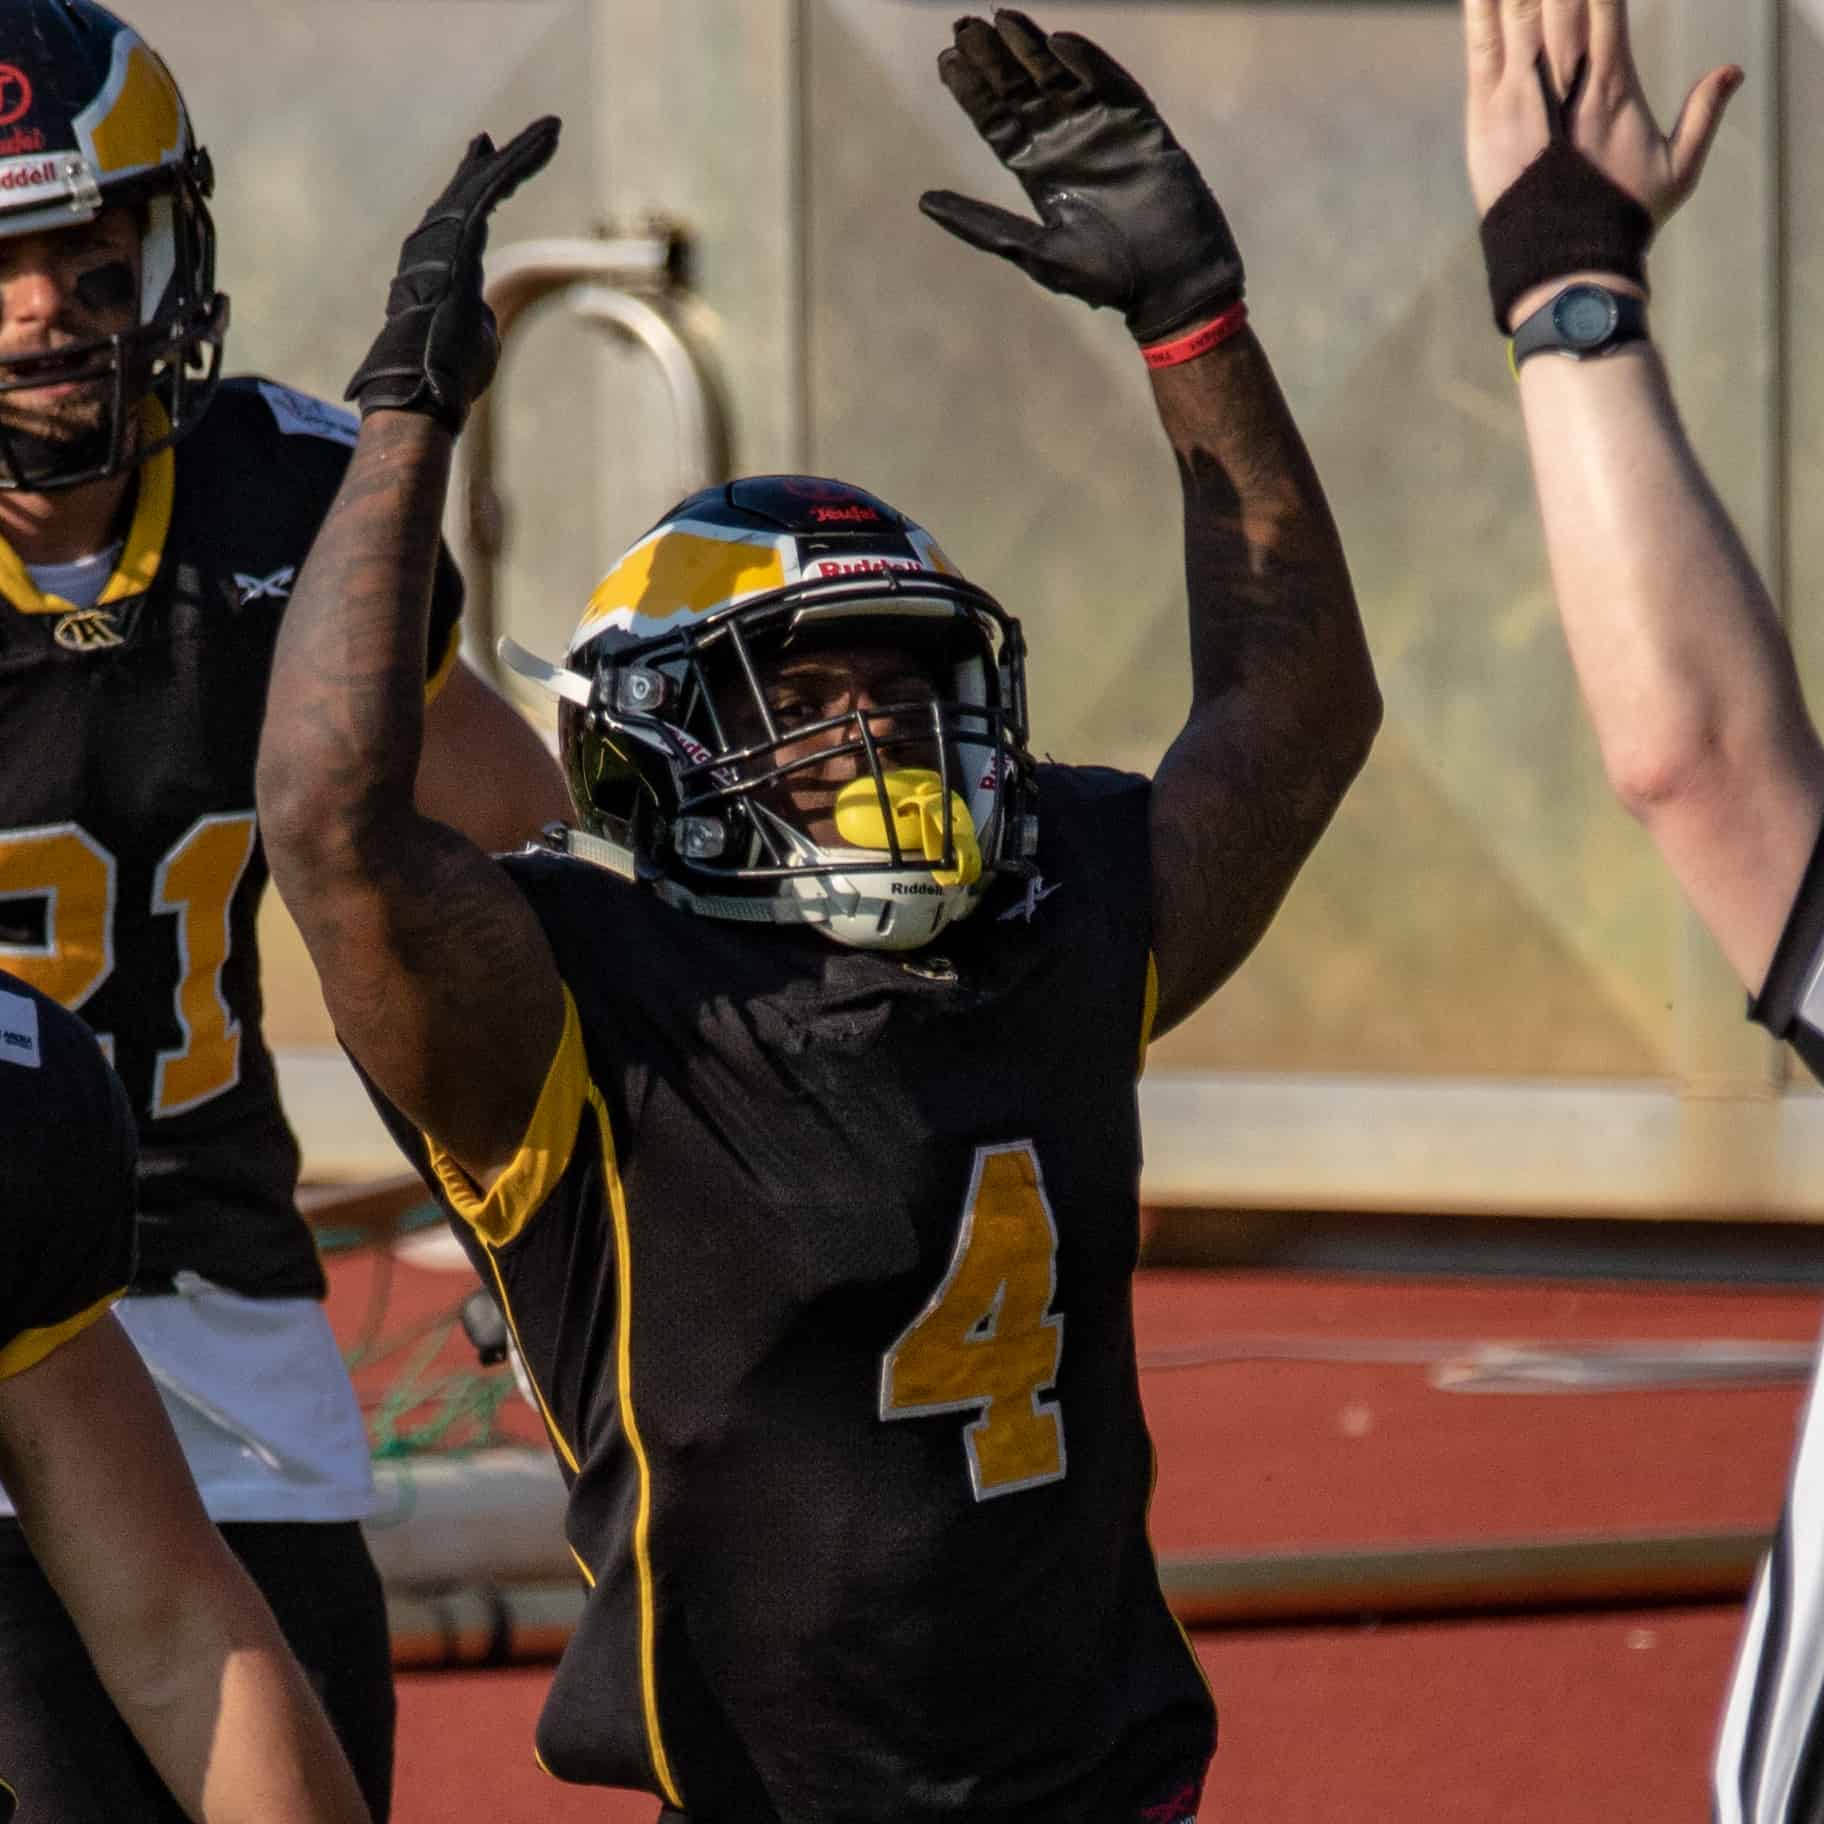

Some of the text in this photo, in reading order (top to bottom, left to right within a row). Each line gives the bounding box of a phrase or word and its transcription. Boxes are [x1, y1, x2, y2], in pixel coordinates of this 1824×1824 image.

[817, 559, 922, 578] Riddell
[891, 882, 943, 898] Riddell
[879, 1138, 1067, 1502] 4
